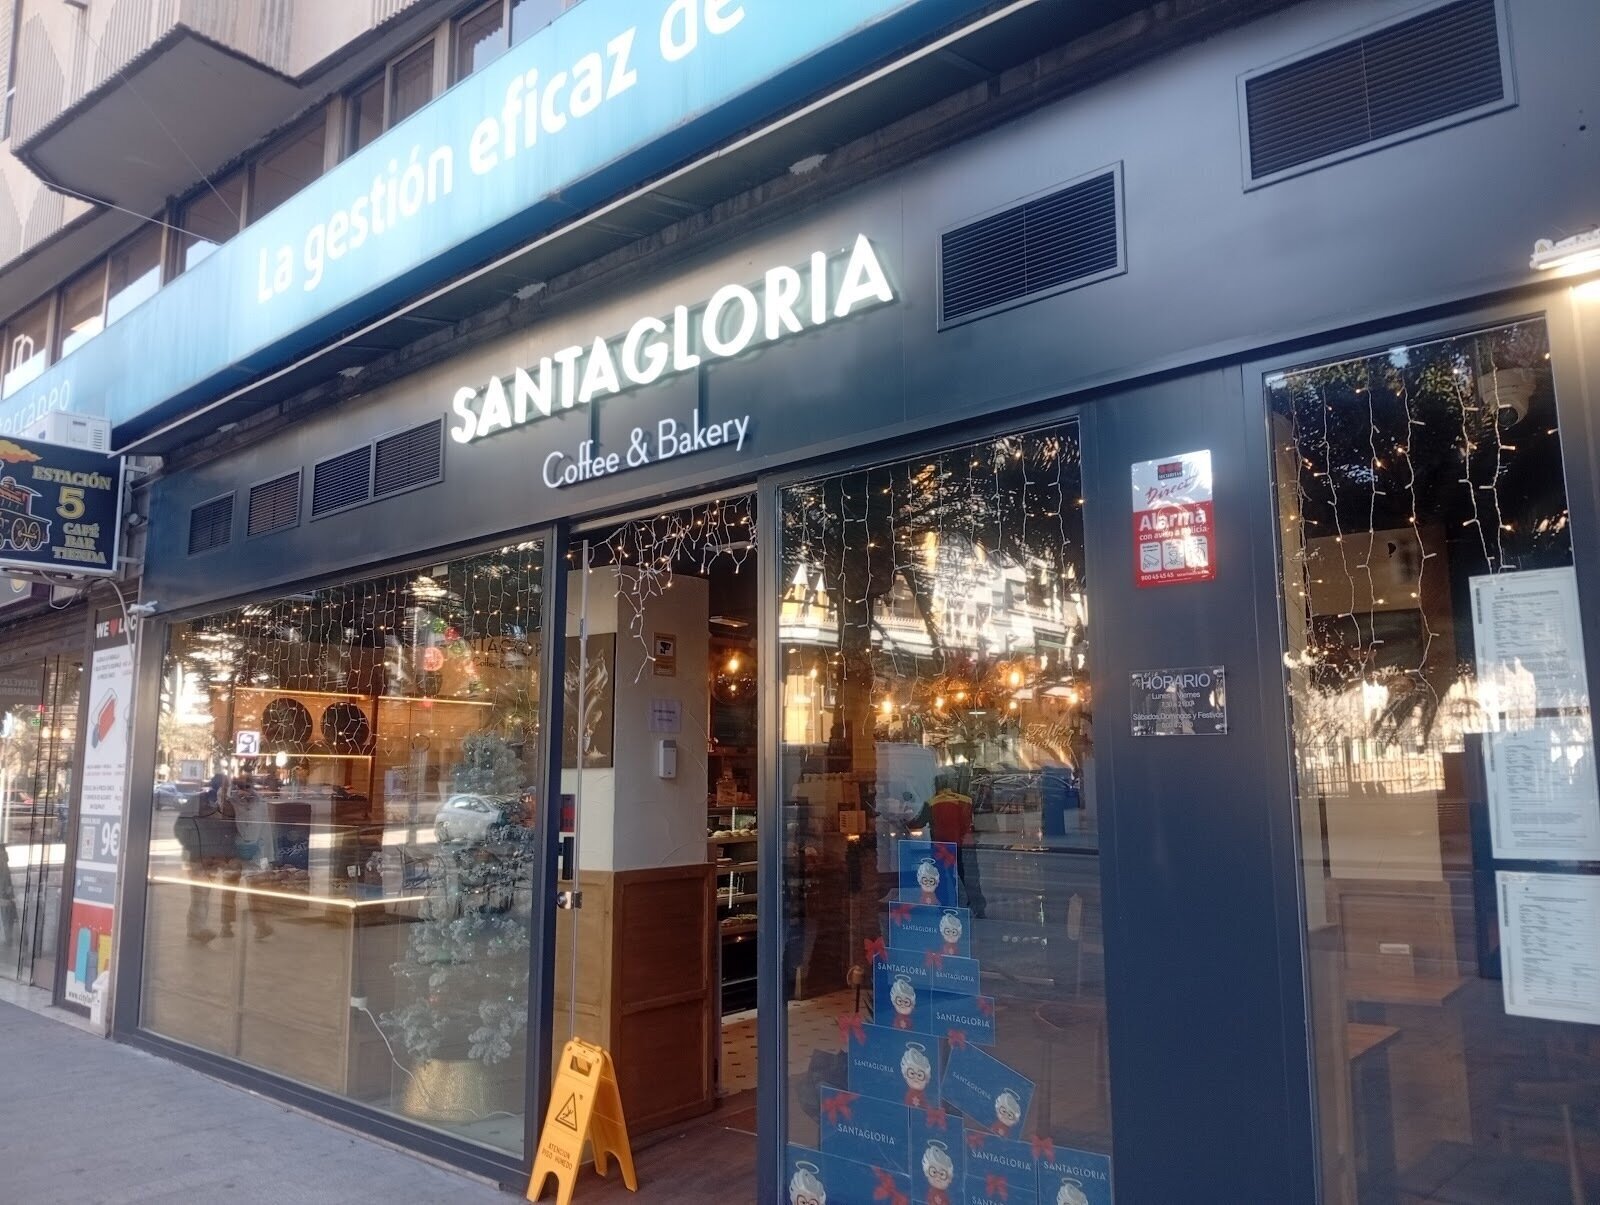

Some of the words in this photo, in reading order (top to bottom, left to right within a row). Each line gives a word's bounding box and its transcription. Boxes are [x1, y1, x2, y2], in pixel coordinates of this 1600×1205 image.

[257, 243, 294, 305] La
[303, 144, 454, 292] gestión
[468, 25, 638, 176] eficaz
[450, 233, 894, 445] SANTAGLORIA
[542, 439, 619, 489] Coffee
[626, 427, 650, 468] &
[658, 408, 750, 452] Bakery
[31, 465, 113, 490] ESTACIÓN
[56, 485, 85, 520] 5
[1139, 508, 1207, 531] Alarma
[62, 522, 100, 539] CAFÉ
[1139, 533, 1153, 541] con
[64, 534, 97, 550] BAR
[52, 546, 107, 564] TIENDA
[96, 620, 110, 639] WE
[1141, 673, 1211, 690] HORARIO
[1197, 711, 1224, 720] Festivos
[902, 923, 938, 934] SANTAGLORIA
[877, 962, 927, 977] SANTAGLORIA
[936, 971, 975, 984] SANTAGLORIA
[936, 1011, 991, 1029] SANTAGLORIA
[854, 1058, 894, 1074] SANTAGLORIA
[952, 1071, 993, 1100] SANTAGLORIA
[836, 1123, 896, 1145] SANTAGLORIA
[971, 1150, 1032, 1172] SANTAGLORIA
[1043, 1161, 1107, 1180] SANTAGLORIA
